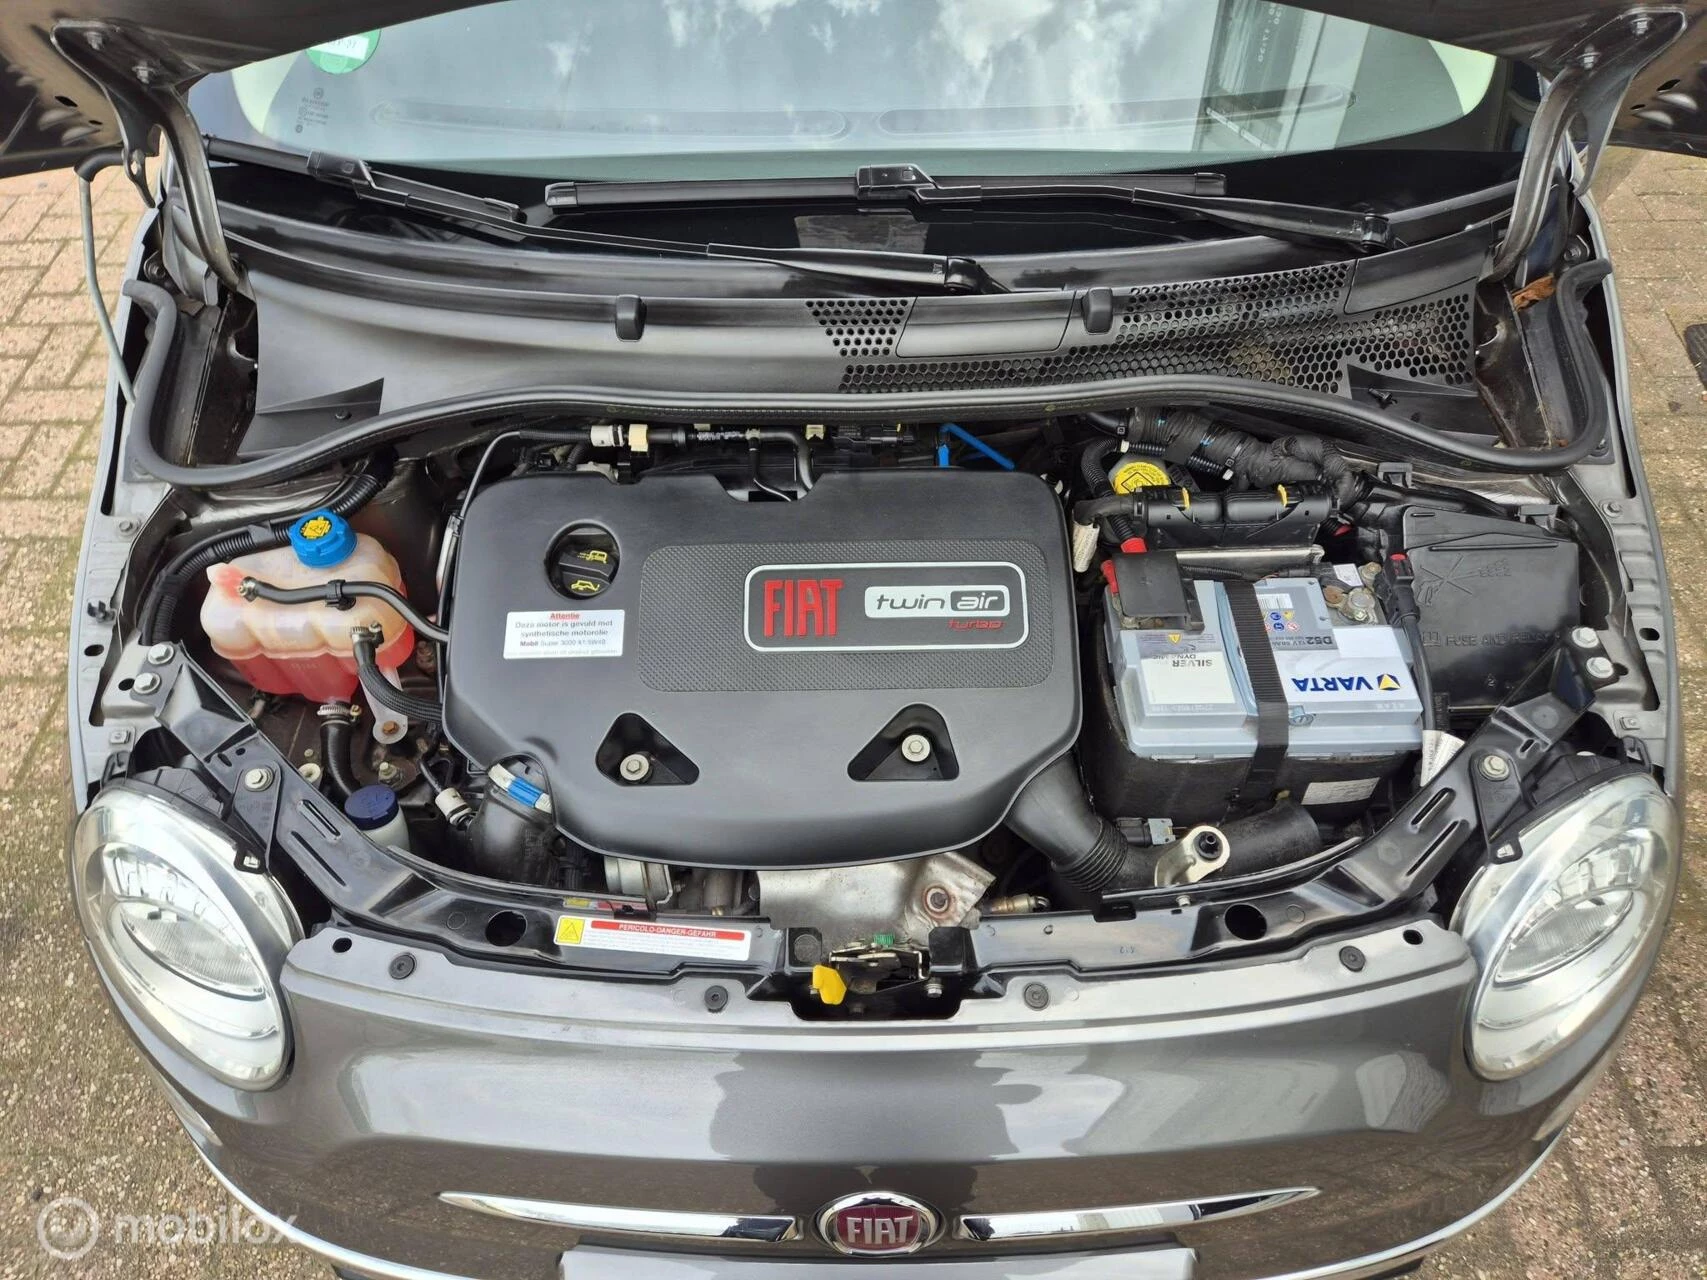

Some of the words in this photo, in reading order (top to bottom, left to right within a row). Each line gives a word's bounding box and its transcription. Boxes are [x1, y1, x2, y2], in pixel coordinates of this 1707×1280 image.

[876, 593, 946, 610] twin
[956, 592, 999, 611] air
[763, 579, 844, 638] FIAT
[550, 612, 580, 620] Attentie
[570, 620, 596, 628] gevuld
[947, 619, 1006, 631] turbo
[520, 630, 570, 638] synthetische
[571, 629, 608, 637] motorolie
[1305, 636, 1333, 646] D52
[1446, 634, 1478, 647] FUSE
[1172, 660, 1214, 668] SILVER
[1290, 676, 1374, 692] VARTA
[846, 1216, 914, 1244] FIAT
